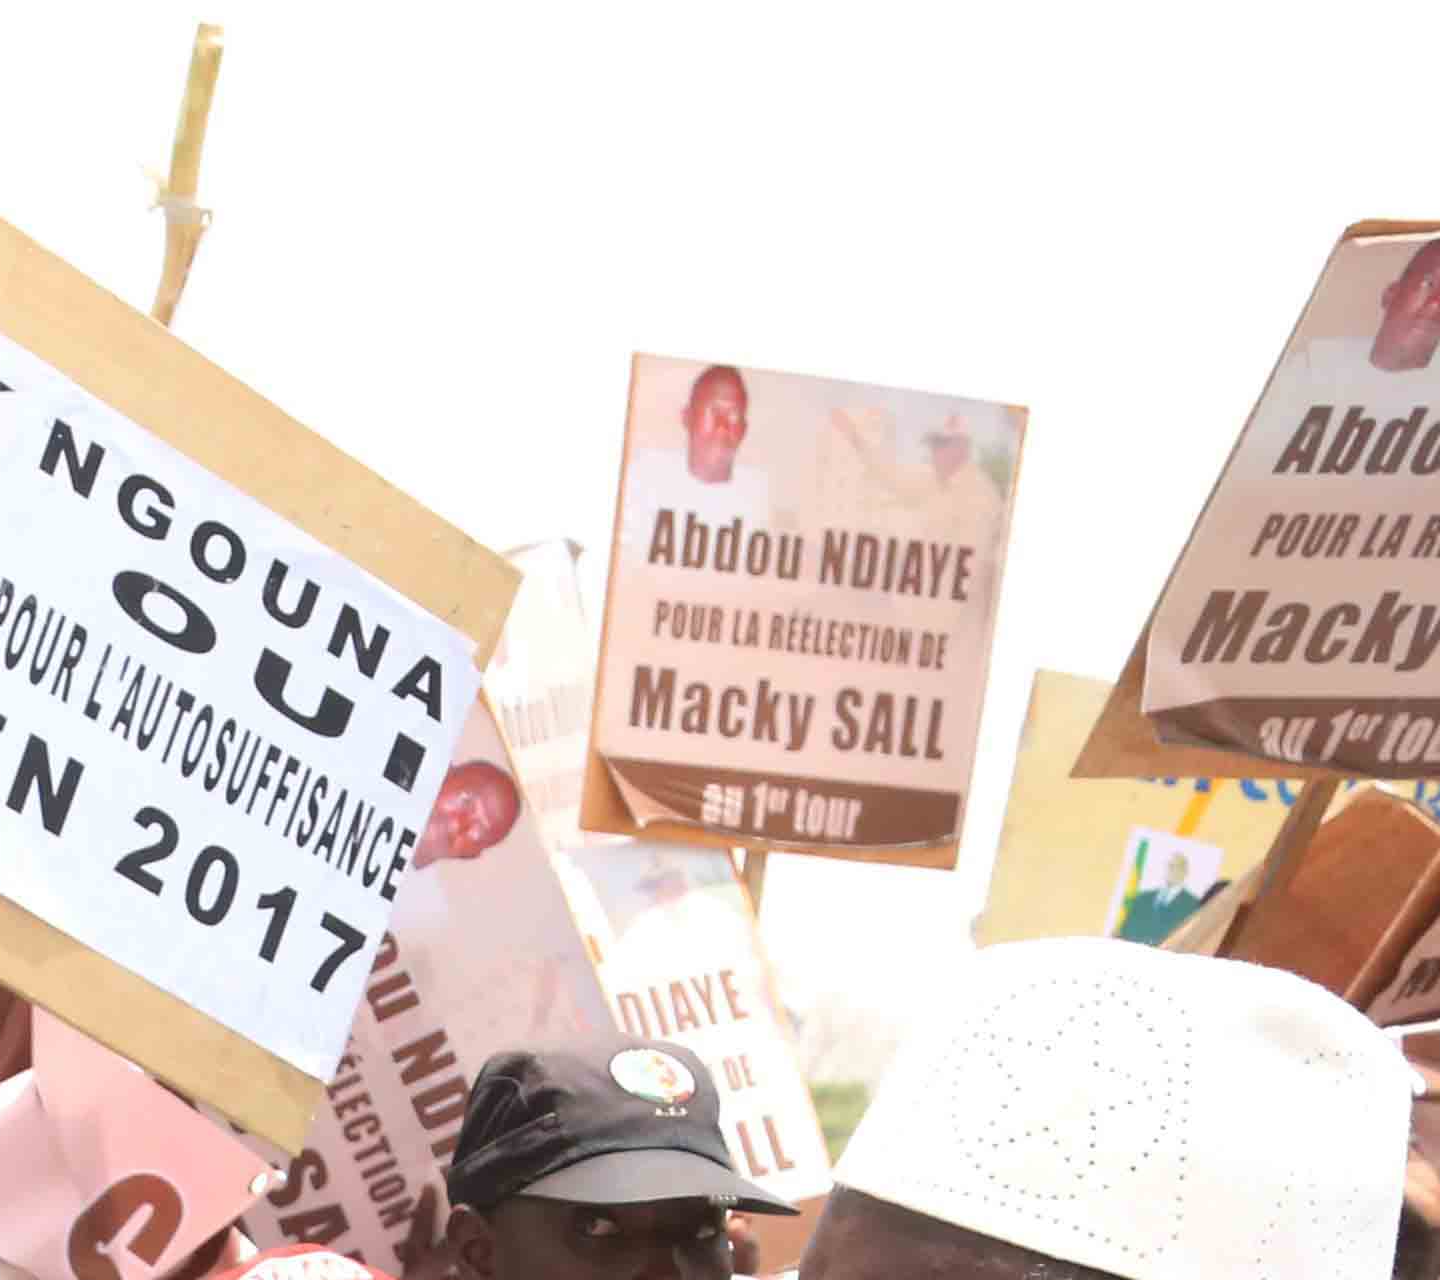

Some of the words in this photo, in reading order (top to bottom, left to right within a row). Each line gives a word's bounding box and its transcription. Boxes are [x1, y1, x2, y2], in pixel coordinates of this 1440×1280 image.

[39, 417, 446, 725] NGOUNA
[648, 509, 802, 583] Abdou
[818, 529, 974, 603] NDIAYE
[1250, 513, 1354, 559] POUR
[1358, 515, 1408, 559] LA
[109, 569, 427, 793] OUI
[654, 600, 725, 645] POUR
[731, 606, 762, 648] LA
[919, 631, 948, 671] DE
[629, 667, 816, 753] Macky
[832, 687, 946, 761] SALL
[1258, 715, 1316, 762] au
[85, 640, 419, 903] L'AUTOSUFFISANCE
[700, 784, 743, 823] au
[794, 786, 862, 840] tour
[114, 806, 368, 996] 2017
